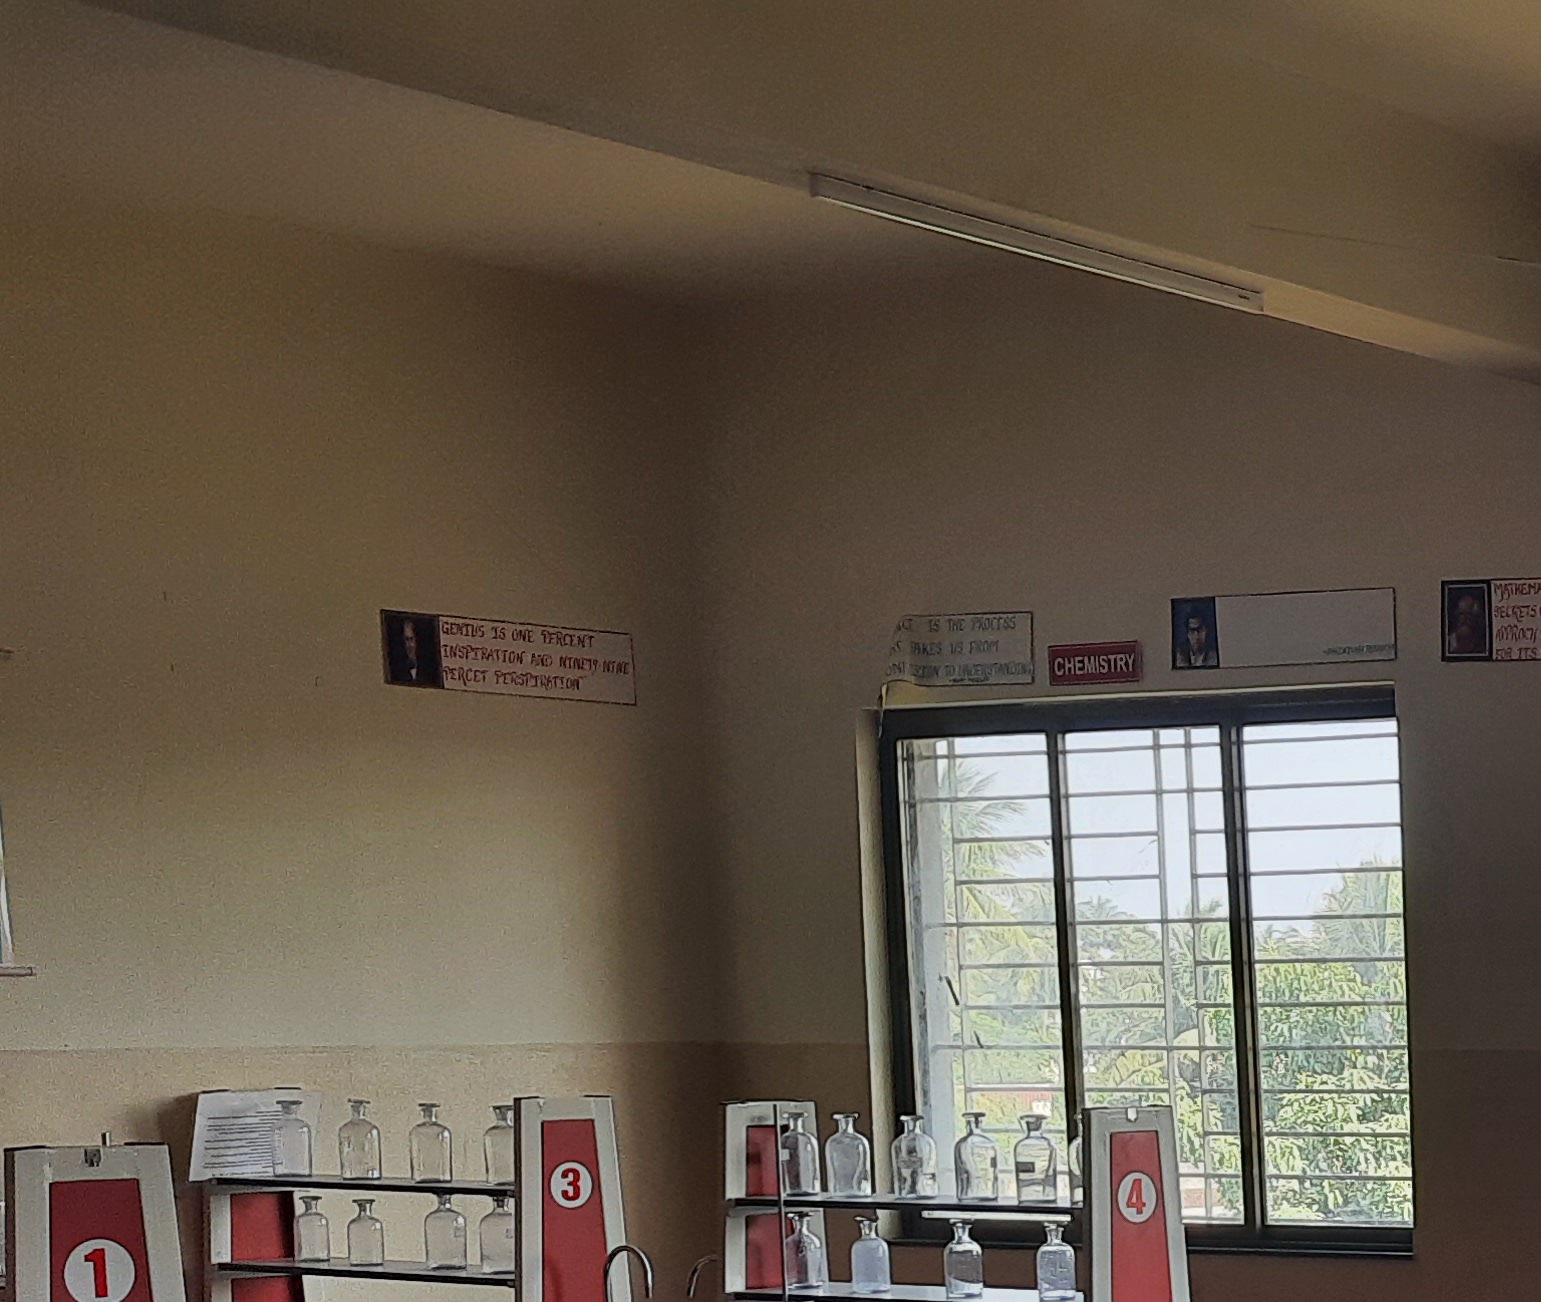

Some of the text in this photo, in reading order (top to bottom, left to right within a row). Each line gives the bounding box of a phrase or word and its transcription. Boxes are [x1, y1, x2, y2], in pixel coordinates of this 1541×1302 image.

[948, 618, 965, 632] THE
[971, 616, 1016, 632] PROCESS
[1494, 604, 1537, 622] SECRETS
[441, 622, 595, 648] GENIUS IS ONE PERCENT
[442, 644, 526, 666] INSPIRATION
[530, 652, 553, 668] AND
[950, 641, 963, 654] US
[969, 640, 999, 655] FROM
[1518, 647, 1537, 659] ITS
[1054, 653, 1135, 676] CHEMISTRY
[561, 1168, 580, 1202] 3
[1126, 1178, 1146, 1215] 4
[84, 1248, 108, 1298] 1
